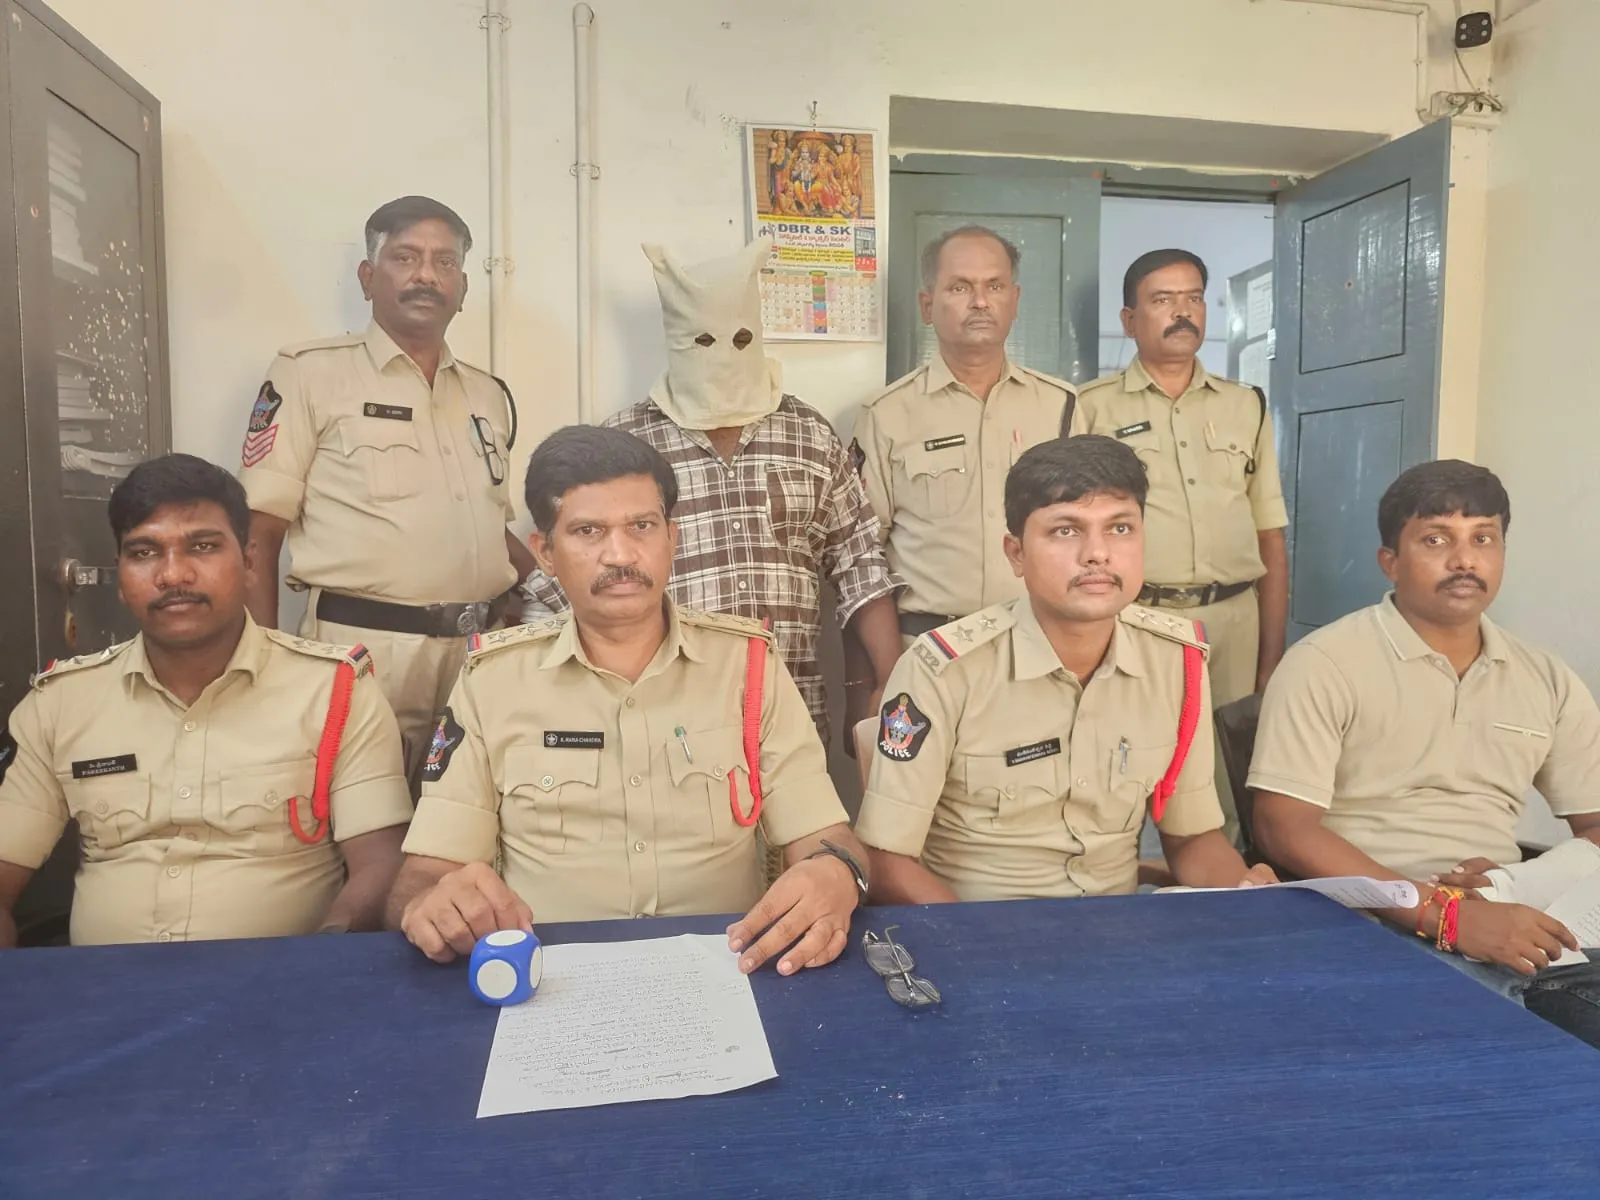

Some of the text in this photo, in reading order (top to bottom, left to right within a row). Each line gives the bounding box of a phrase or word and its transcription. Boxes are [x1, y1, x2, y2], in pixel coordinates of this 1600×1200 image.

[778, 223, 851, 235] DBR & SK
[880, 740, 912, 758] POLICE
